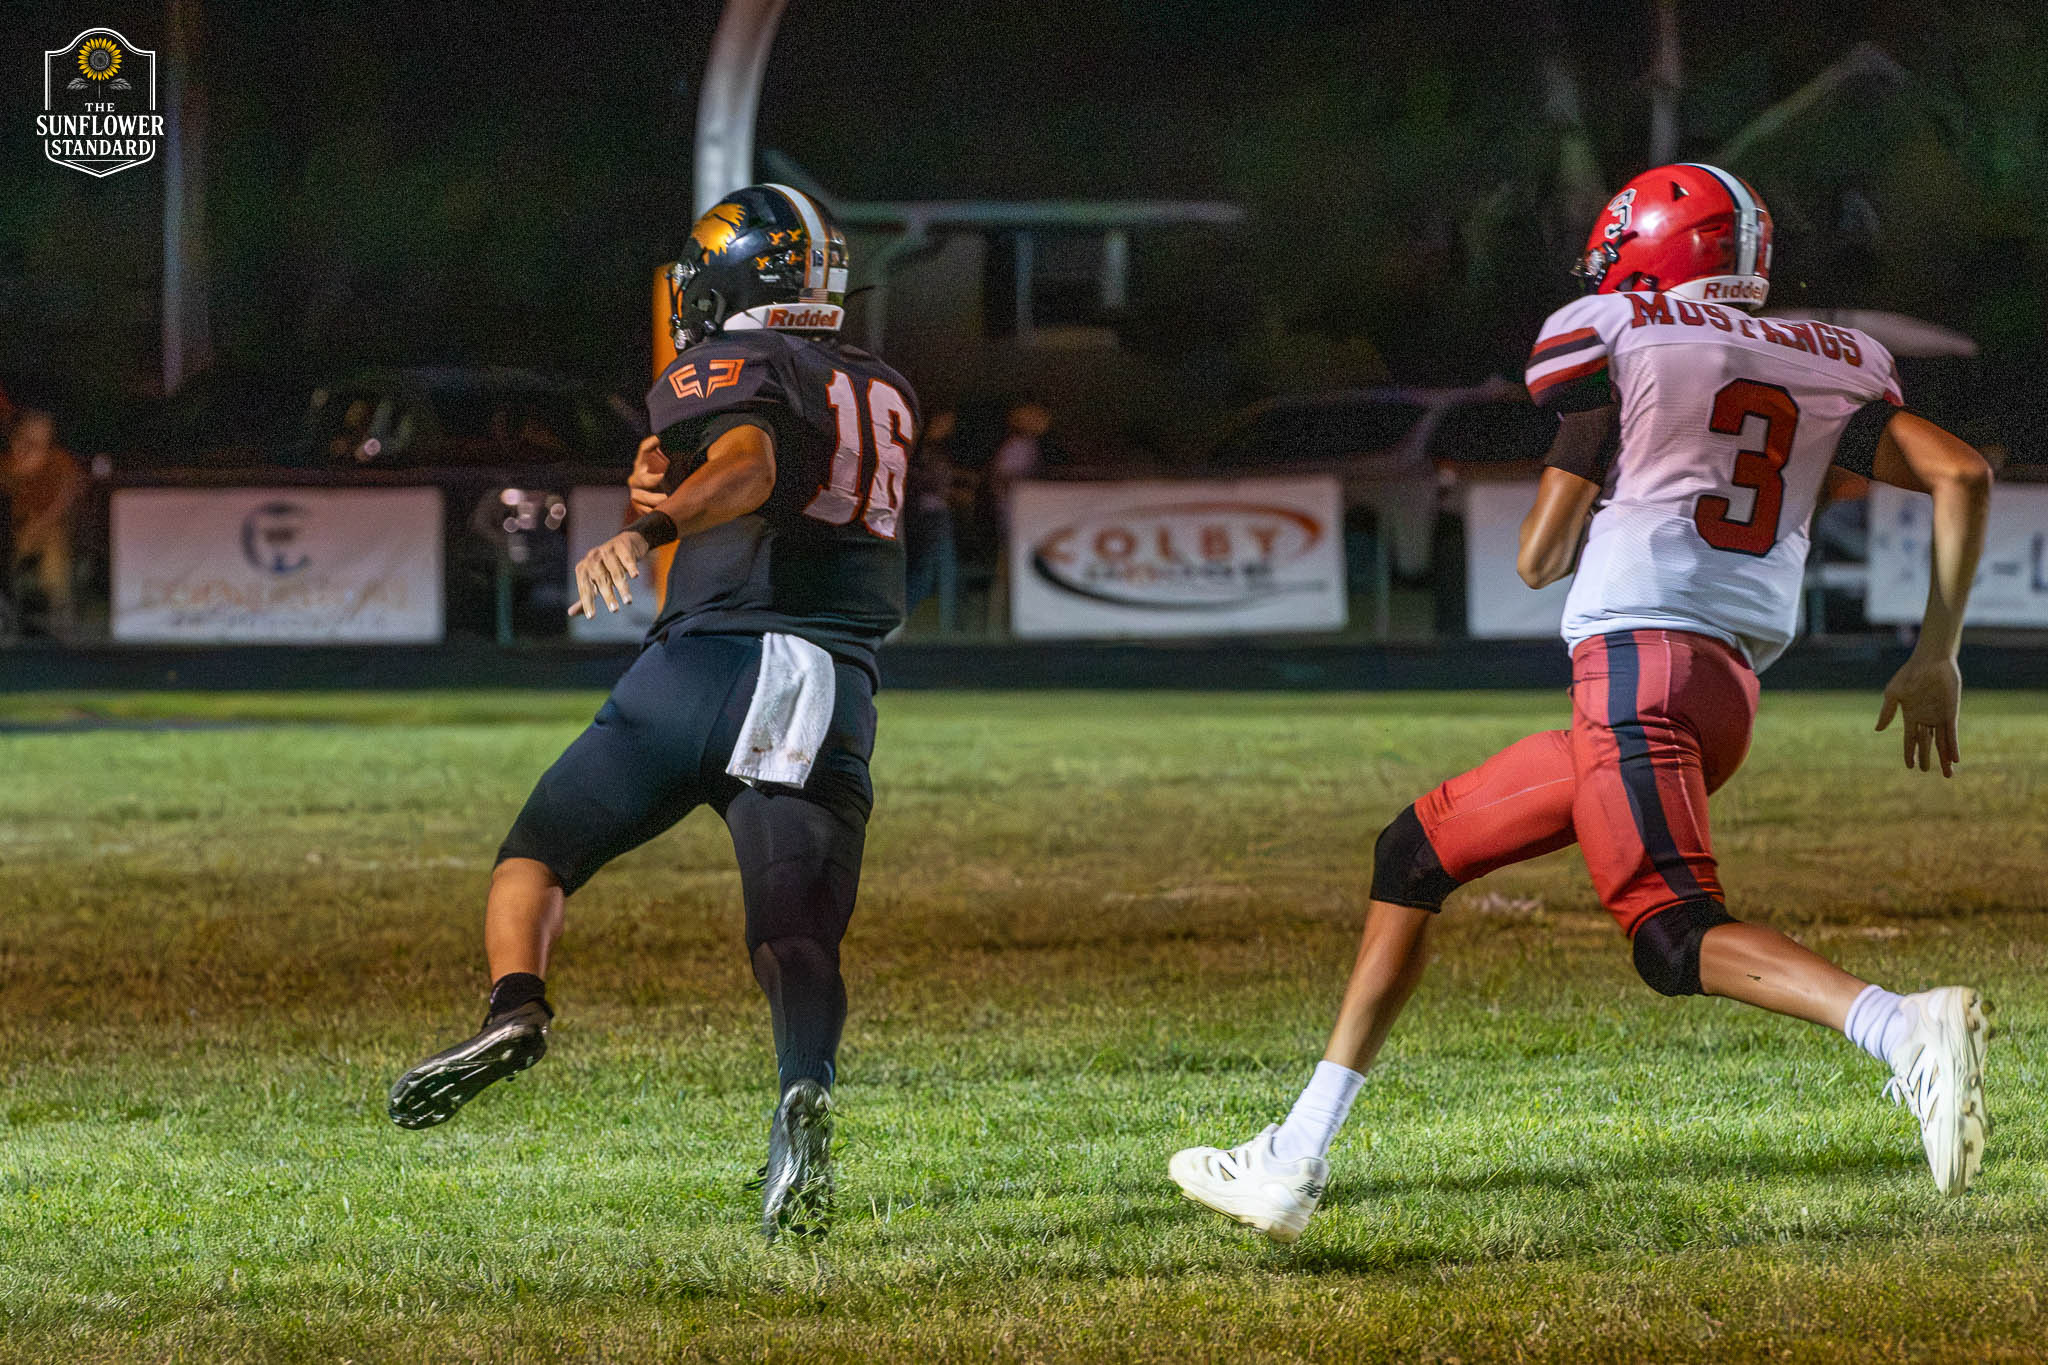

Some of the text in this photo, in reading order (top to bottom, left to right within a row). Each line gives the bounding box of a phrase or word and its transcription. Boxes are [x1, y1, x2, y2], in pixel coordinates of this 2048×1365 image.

[802, 369, 915, 541] 16
[1693, 377, 1799, 558] 3
[1041, 523, 1281, 566] COLBY
